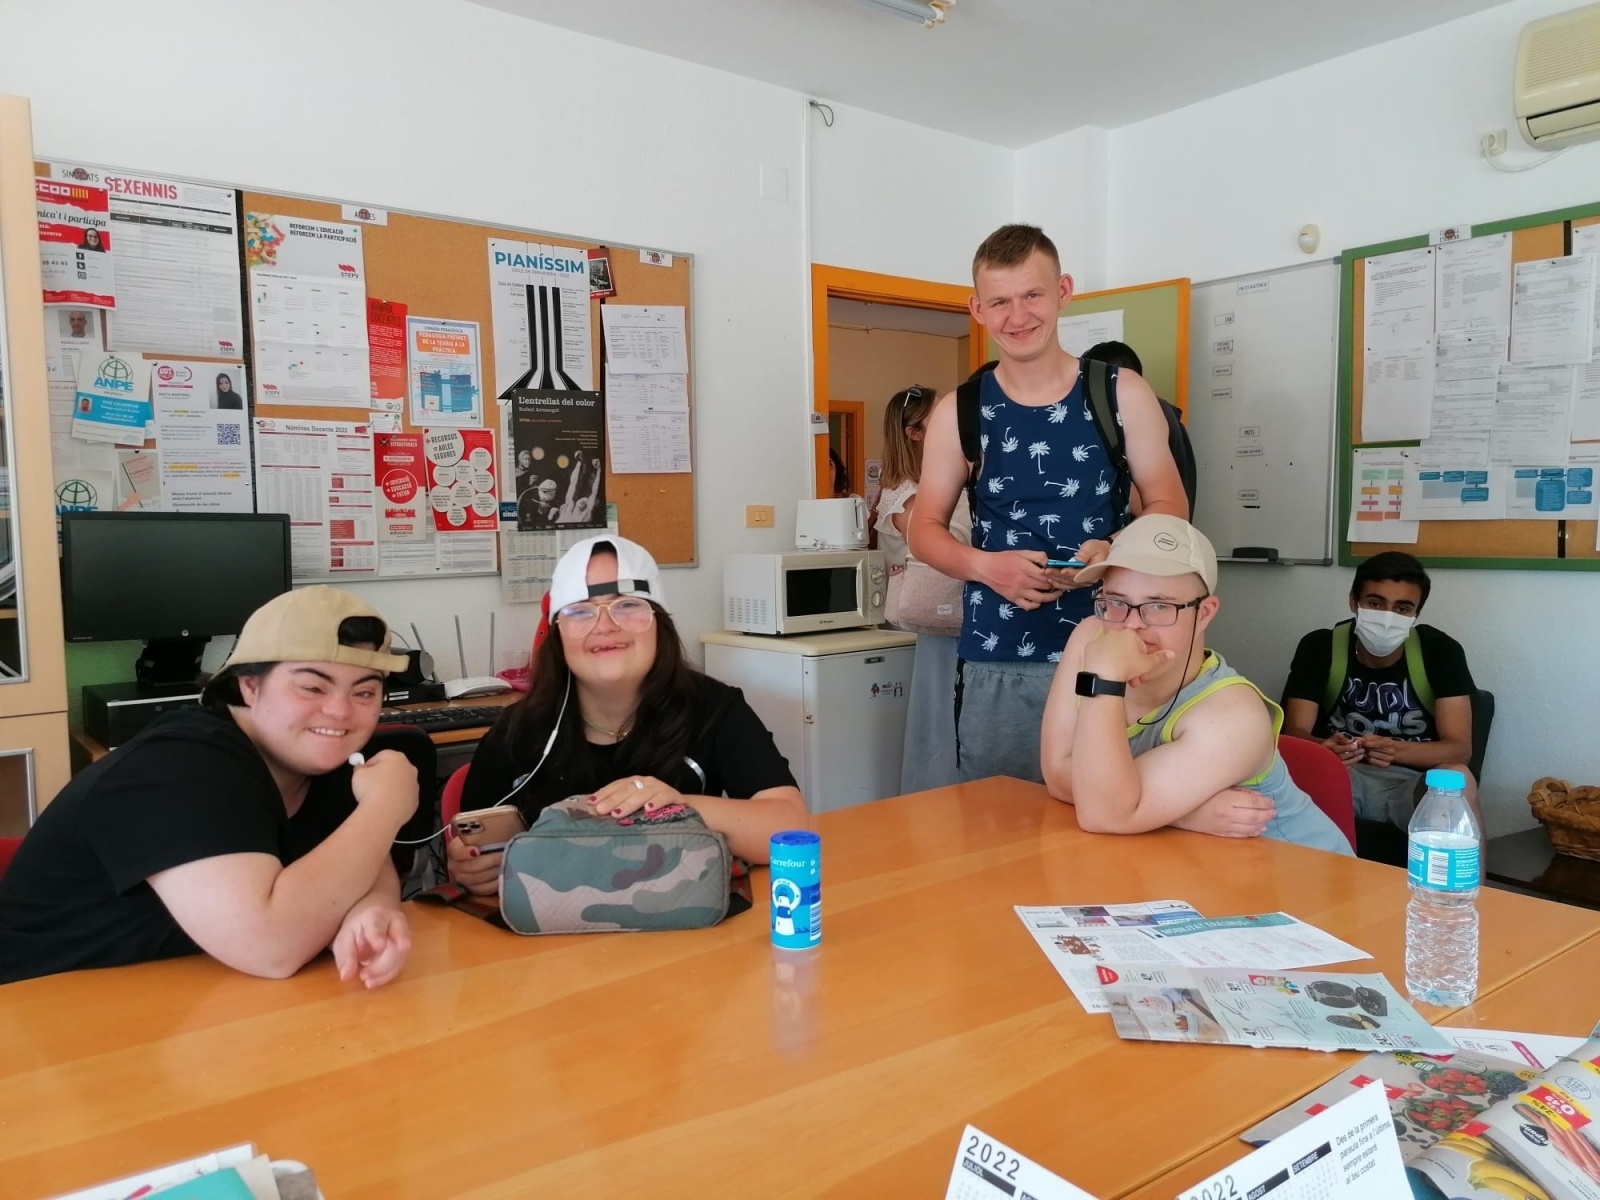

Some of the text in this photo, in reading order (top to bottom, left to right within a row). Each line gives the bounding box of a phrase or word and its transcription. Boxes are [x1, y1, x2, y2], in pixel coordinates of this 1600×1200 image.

[104, 176, 178, 200] SEXENNIS
[67, 214, 106, 227] participa
[289, 223, 315, 231] REFORCEM
[290, 230, 316, 238] REFORCEM
[495, 253, 584, 274] PIANÍSSIM
[94, 377, 134, 391] ANPE
[518, 396, 560, 405] L'entrellat
[562, 398, 574, 406] del
[431, 432, 458, 443] RECURSOS
[433, 450, 456, 460] SEGURES
[438, 443, 454, 452] AULES
[1161, 923, 1203, 934] MOBILITAT
[1336, 1114, 1379, 1146] Des de la primera
[966, 1135, 1020, 1180] 2022
[1340, 1141, 1359, 1160] paraula
[963, 1160, 984, 1177] JULIOL
[1293, 1151, 1319, 1173] SETEMBRE
[1343, 1154, 1362, 1172] sempre
[1346, 1158, 1376, 1185] al teu costat
[1191, 1175, 1238, 1200] 022
[1247, 1185, 1266, 1200] AGOST
